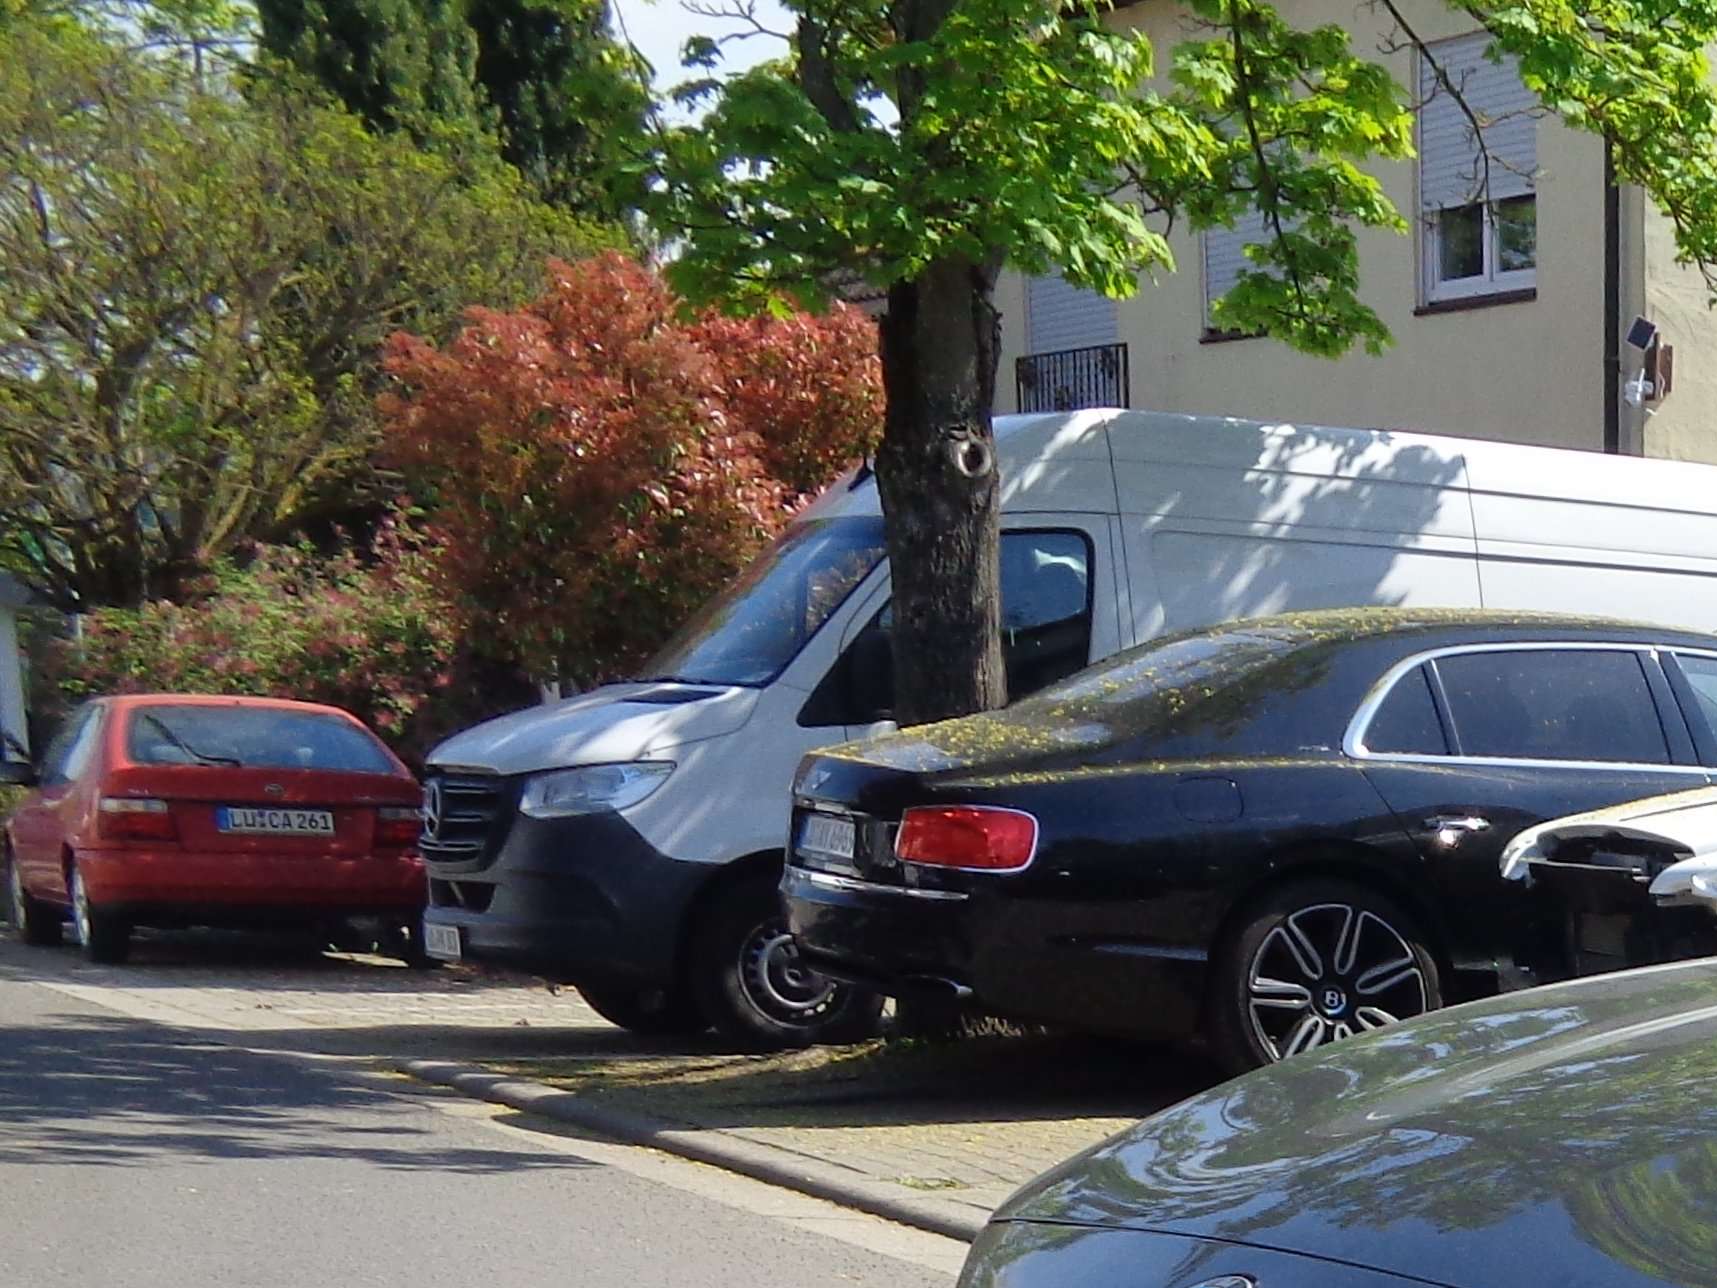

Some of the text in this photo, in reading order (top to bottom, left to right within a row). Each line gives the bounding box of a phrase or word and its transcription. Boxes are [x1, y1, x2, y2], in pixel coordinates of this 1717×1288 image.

[231, 810, 331, 830] LU CA 261
